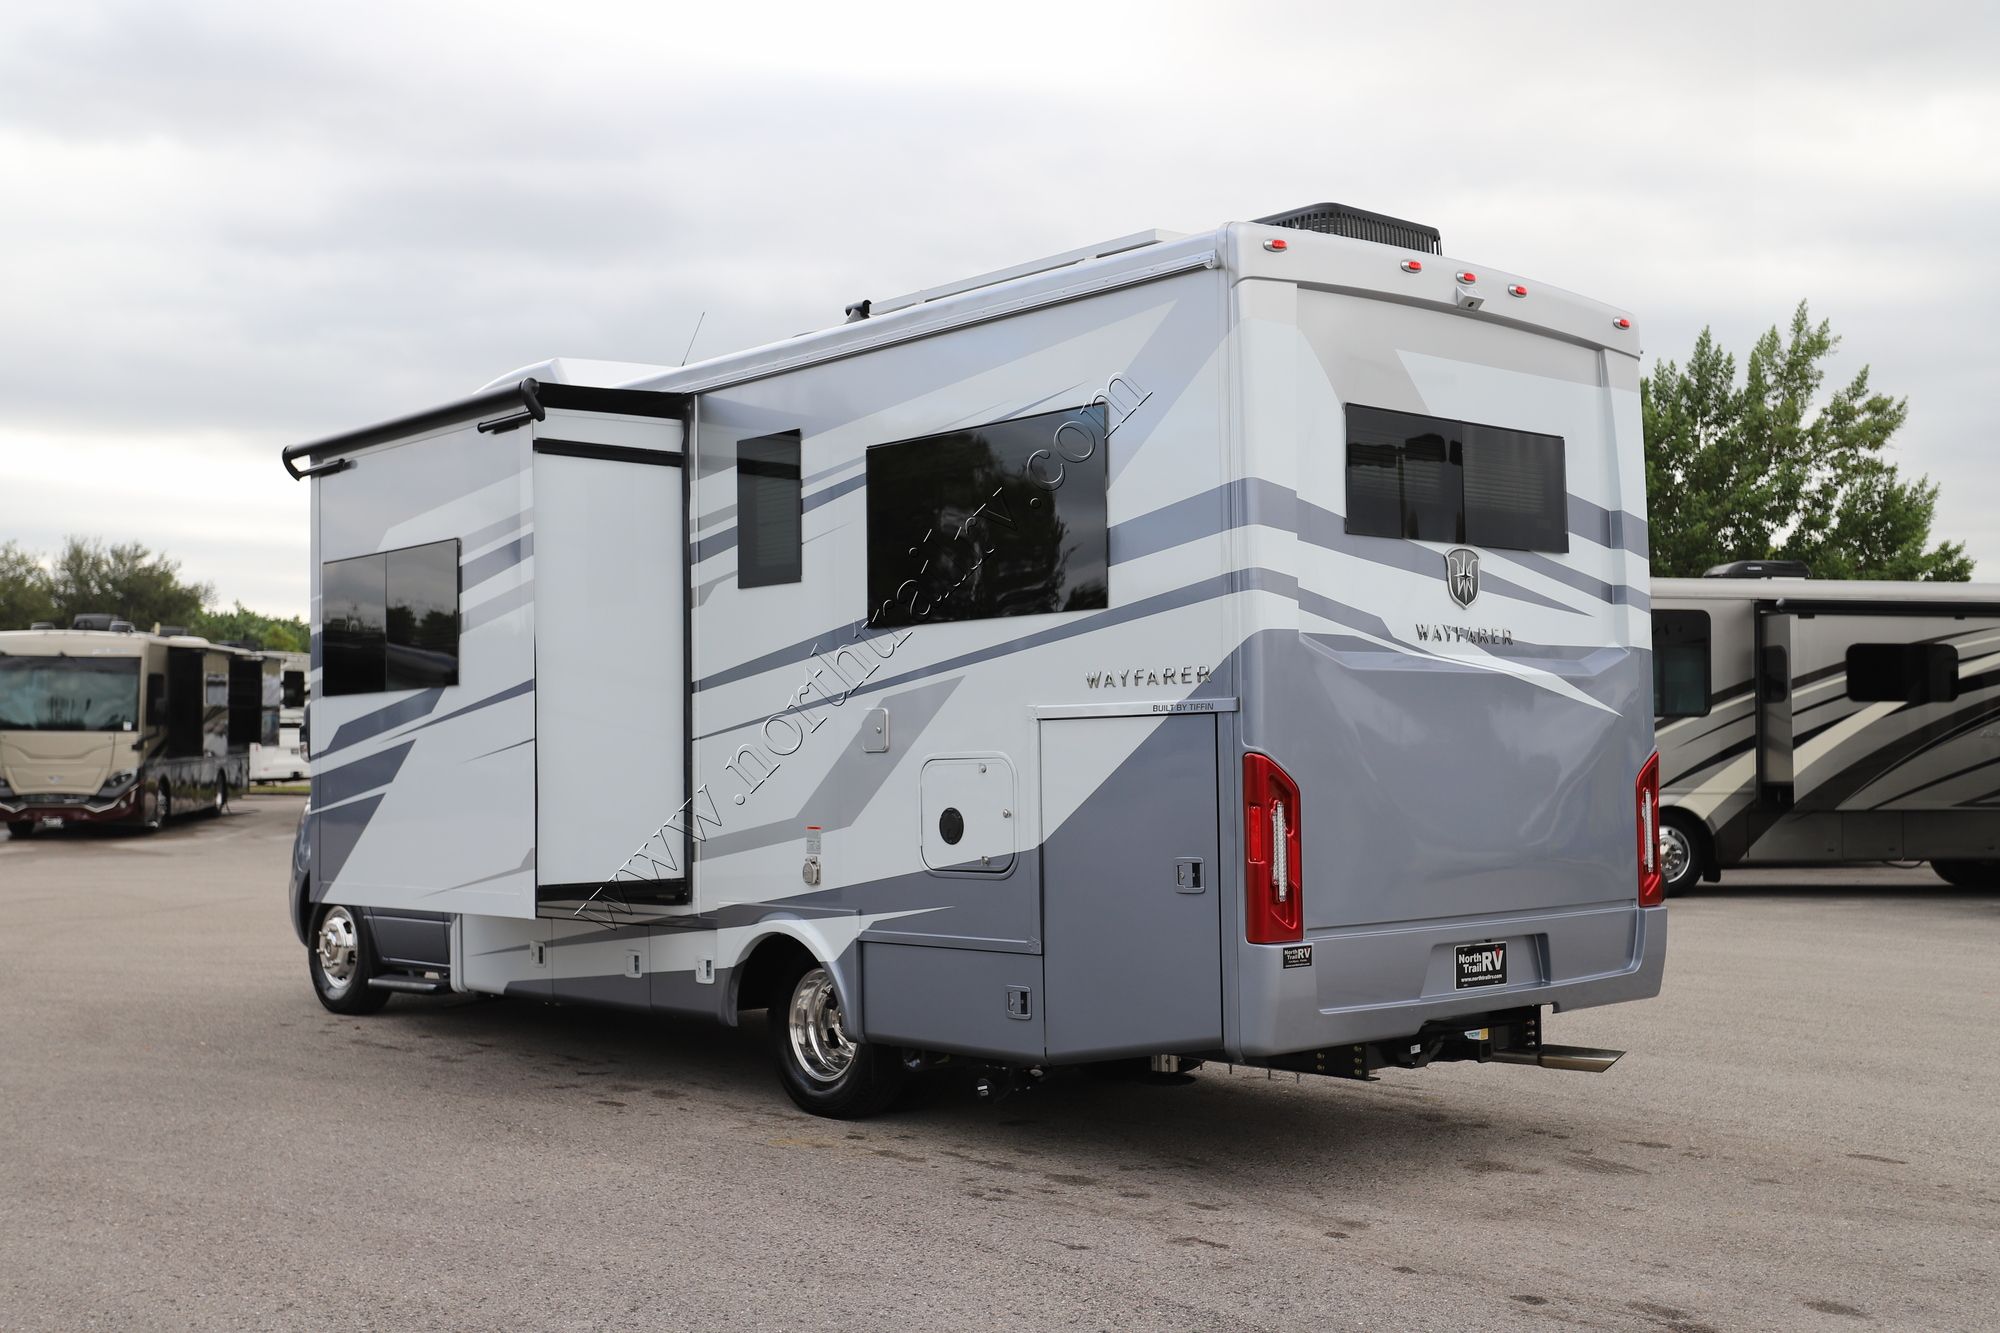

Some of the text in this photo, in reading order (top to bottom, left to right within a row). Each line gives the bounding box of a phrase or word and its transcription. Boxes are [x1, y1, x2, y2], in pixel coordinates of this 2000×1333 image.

[1415, 623, 1513, 645] WAYFARER
[1085, 665, 1211, 689] WAYFARER
[1152, 702, 1214, 712] BUILT BY TIFFIN
[1298, 947, 1311, 959] RV
[1458, 953, 1482, 964] North
[1482, 947, 1504, 972] RV
[1463, 963, 1482, 974] Trail
